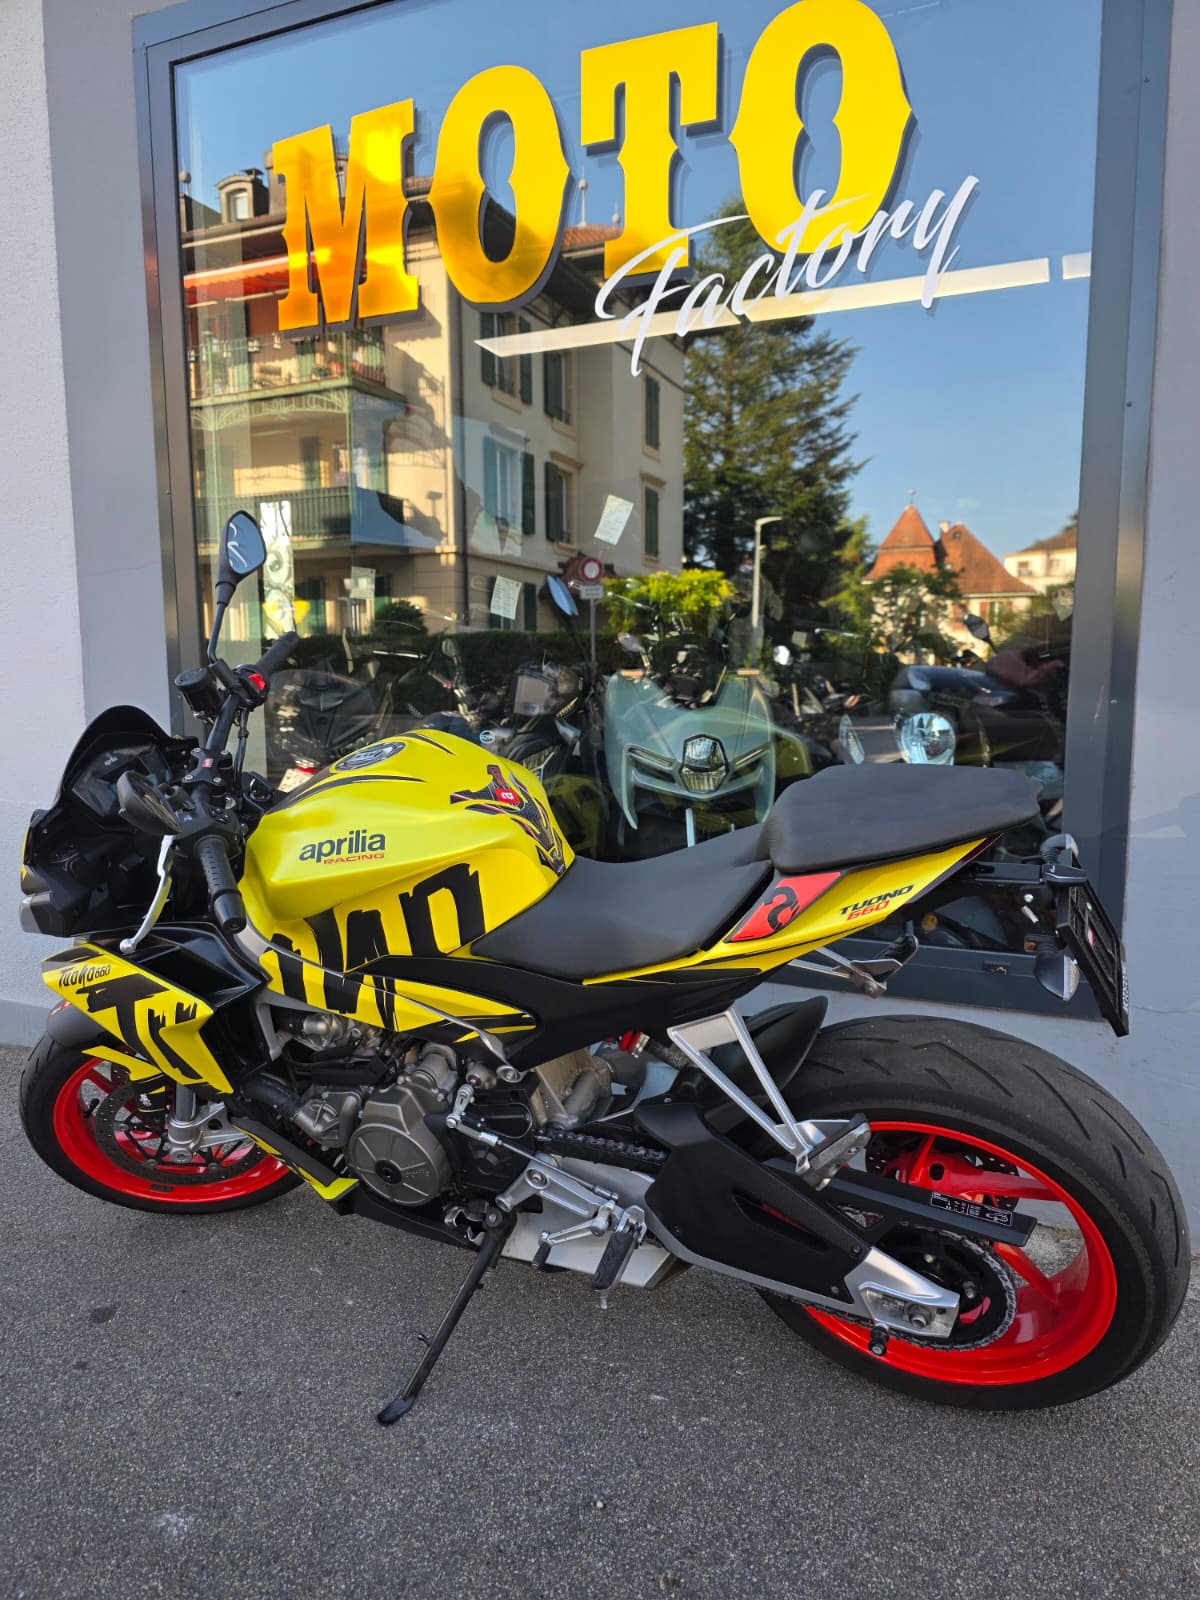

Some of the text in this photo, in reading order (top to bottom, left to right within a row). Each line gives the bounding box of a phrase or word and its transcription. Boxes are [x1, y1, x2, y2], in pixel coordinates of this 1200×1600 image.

[272, 0, 912, 331] MOTO
[594, 175, 980, 377] Factory
[298, 829, 386, 863] aprilia
[323, 853, 385, 865] RACING
[840, 884, 914, 915] TUONO
[847, 899, 890, 921] 660
[94, 965, 112, 979] 660
